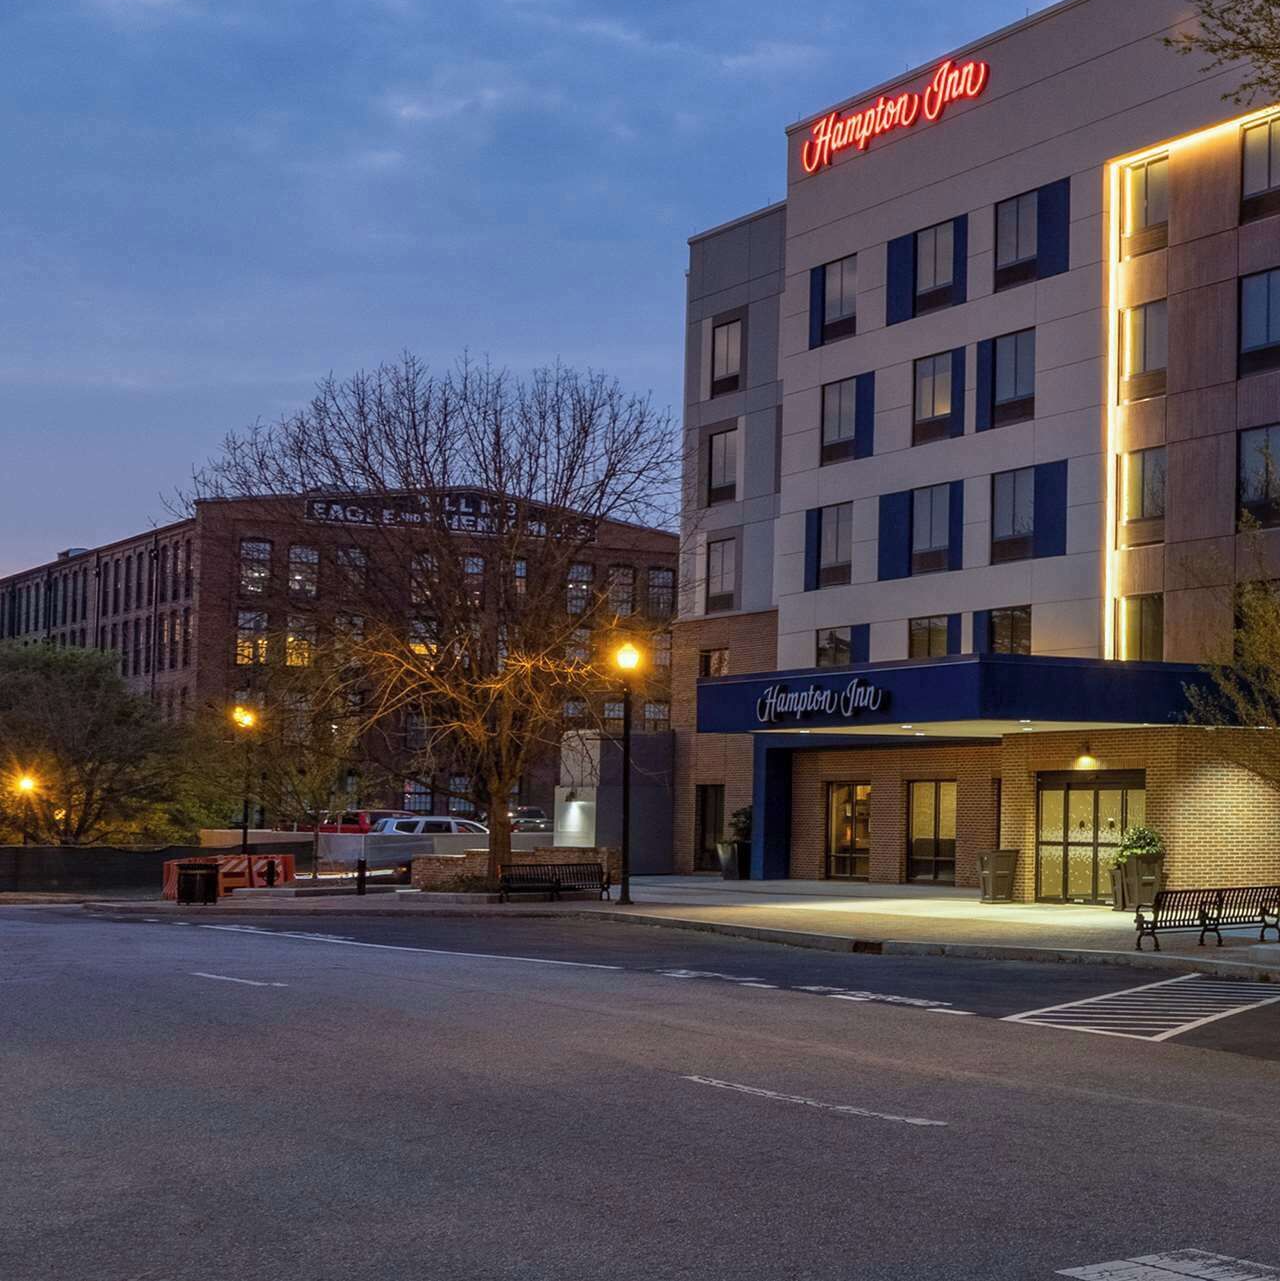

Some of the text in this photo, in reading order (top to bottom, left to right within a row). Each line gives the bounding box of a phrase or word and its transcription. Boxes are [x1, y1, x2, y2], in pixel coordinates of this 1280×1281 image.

[802, 59, 987, 173] Hampton Inn
[756, 678, 882, 722] Hampton Inn
